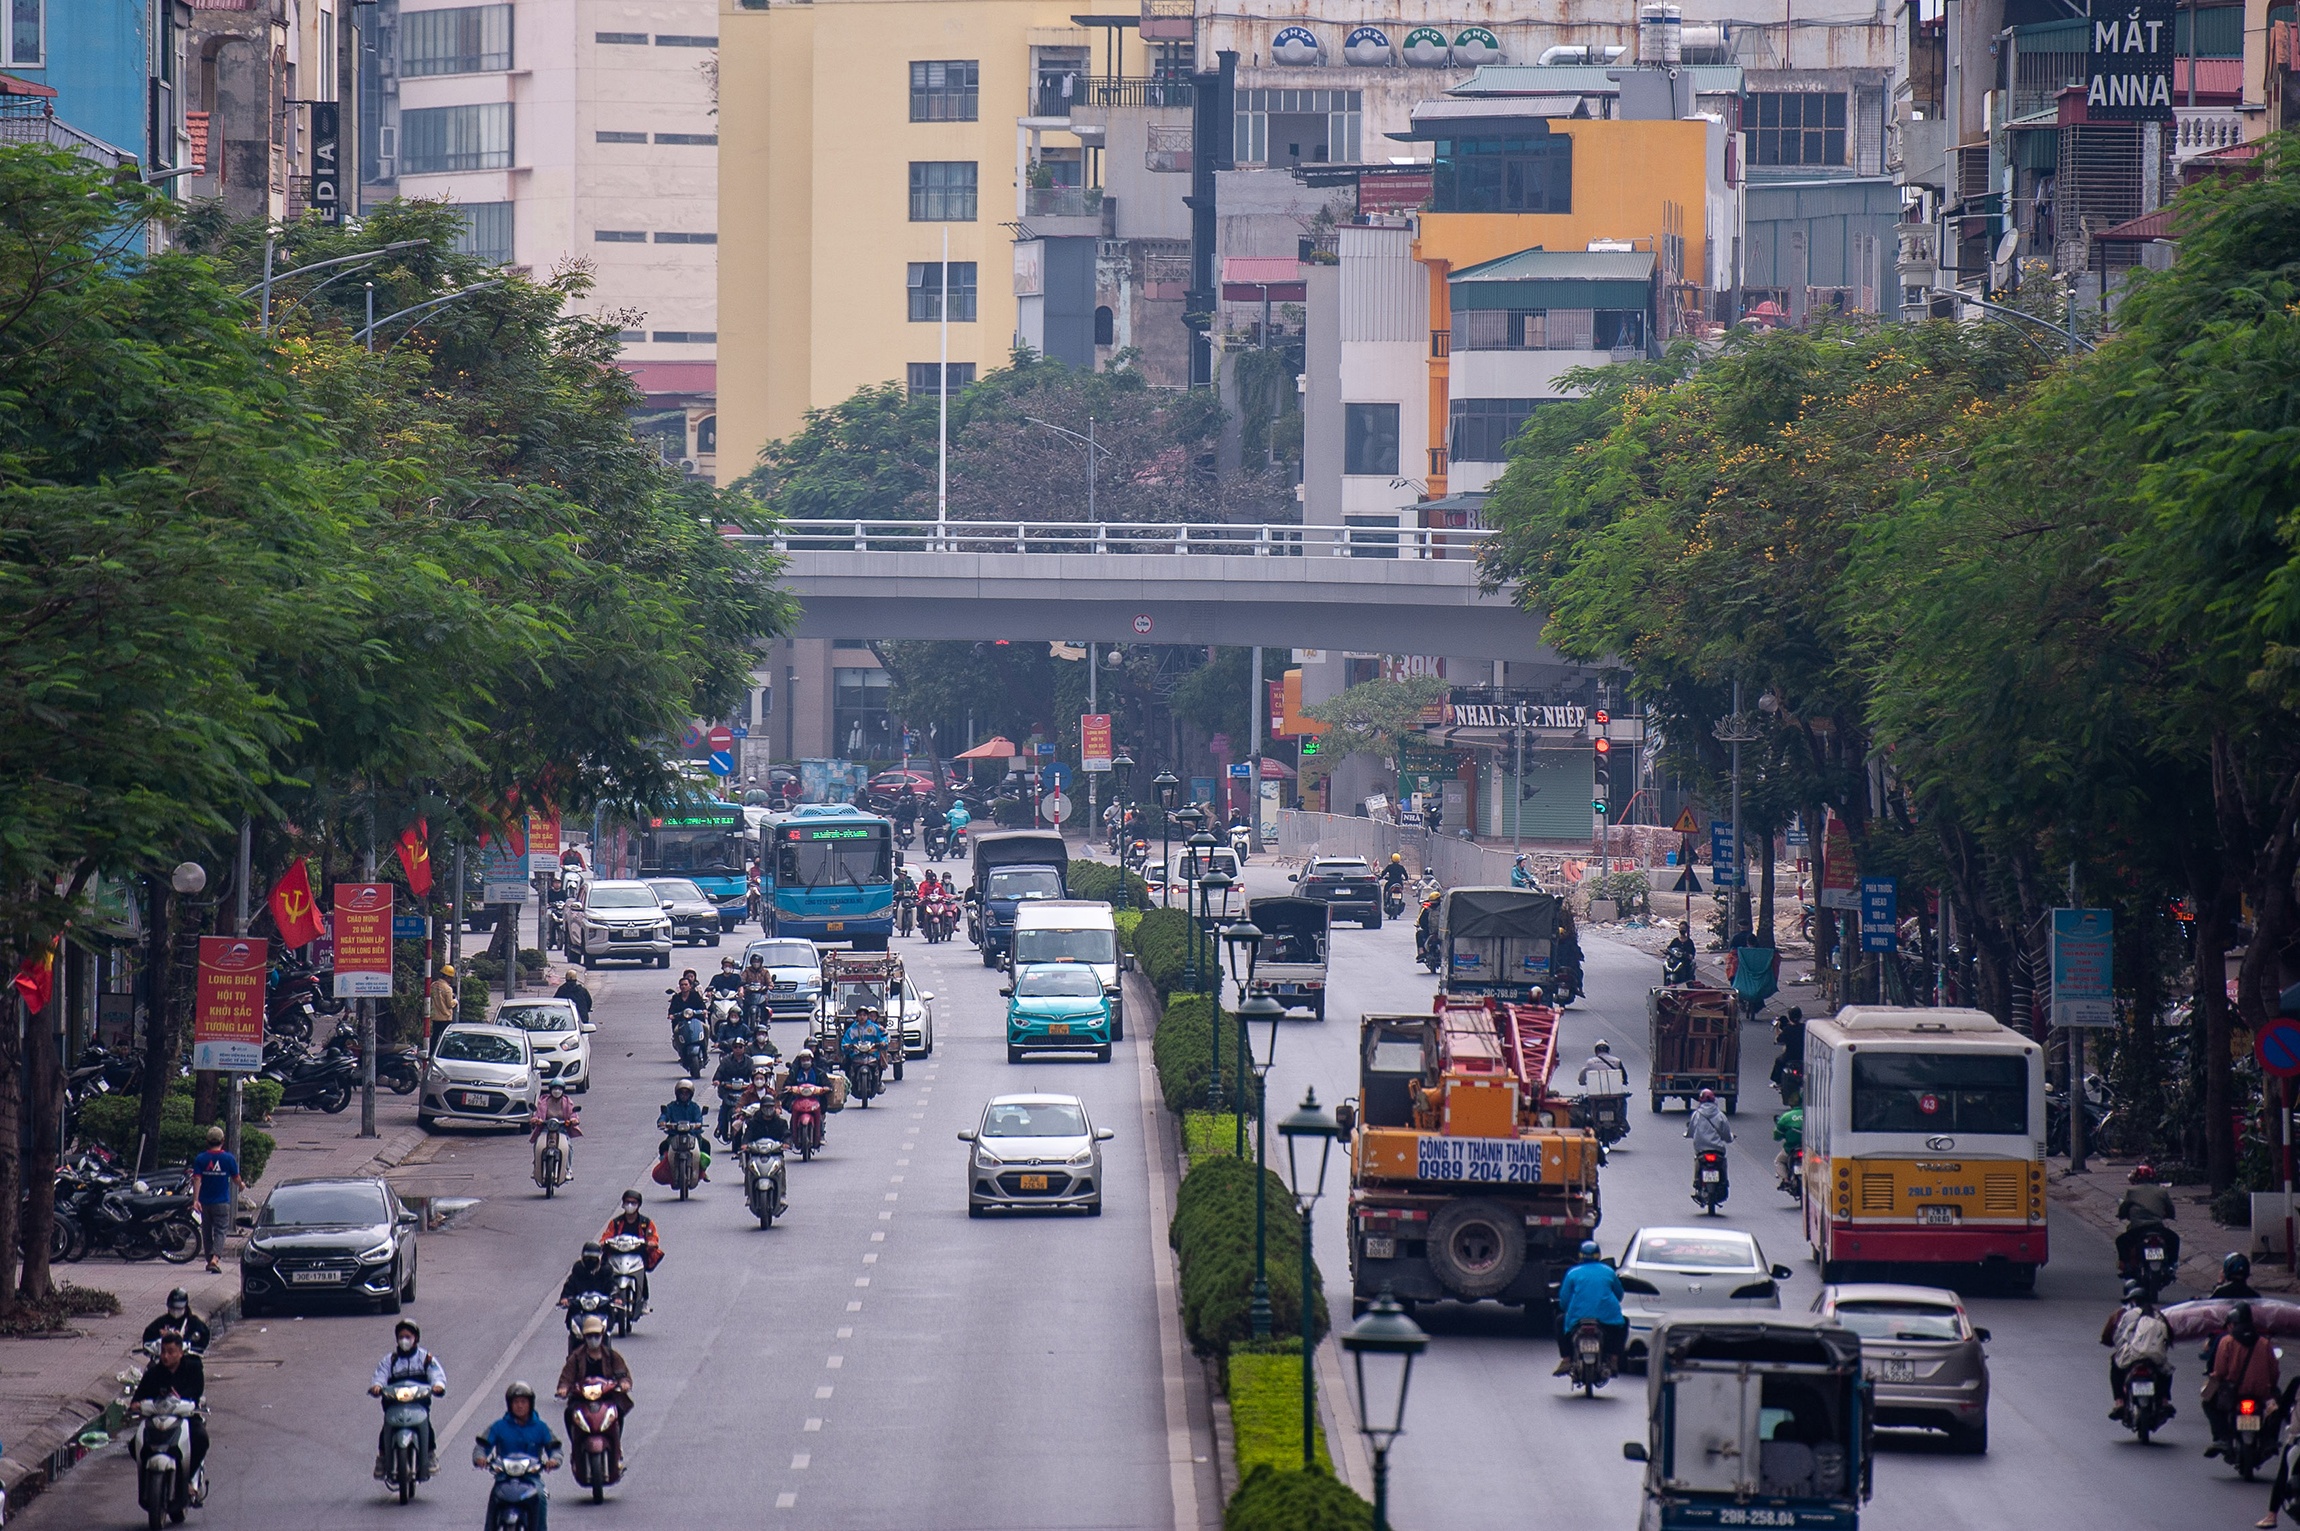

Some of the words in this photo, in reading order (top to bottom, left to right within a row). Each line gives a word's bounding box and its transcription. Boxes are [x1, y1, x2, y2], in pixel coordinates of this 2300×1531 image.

[2095, 6, 2163, 53] MẮT
[1412, 30, 1439, 42] SHG
[1463, 30, 1489, 42] SHG
[2087, 74, 2170, 106] ANNA
[1454, 705, 1495, 726] NHAI
[1542, 701, 1585, 728] NHÉP
[1865, 882, 1877, 893] PHÍA
[1871, 897, 1887, 907] AHEAD
[1863, 923, 1877, 933] CÔNG
[1871, 937, 1888, 946] WORKS
[208, 975, 233, 985] LONG
[234, 974, 257, 986] BIÊN
[217, 989, 233, 1002] HỘI
[235, 991, 246, 1003] TỤ
[209, 1004, 231, 1016] KHỞI
[233, 1004, 252, 1016] SẮC
[205, 1022, 235, 1032] TƯƠNG
[237, 1023, 255, 1033] LAI!
[1419, 1136, 1449, 1160] CÔNG
[1452, 1141, 1464, 1160] TY
[1467, 1137, 1503, 1162] THÀNH
[1418, 1160, 1463, 1180] 0989
[1469, 1162, 1502, 1182] 204
[1508, 1163, 1542, 1184] 206
